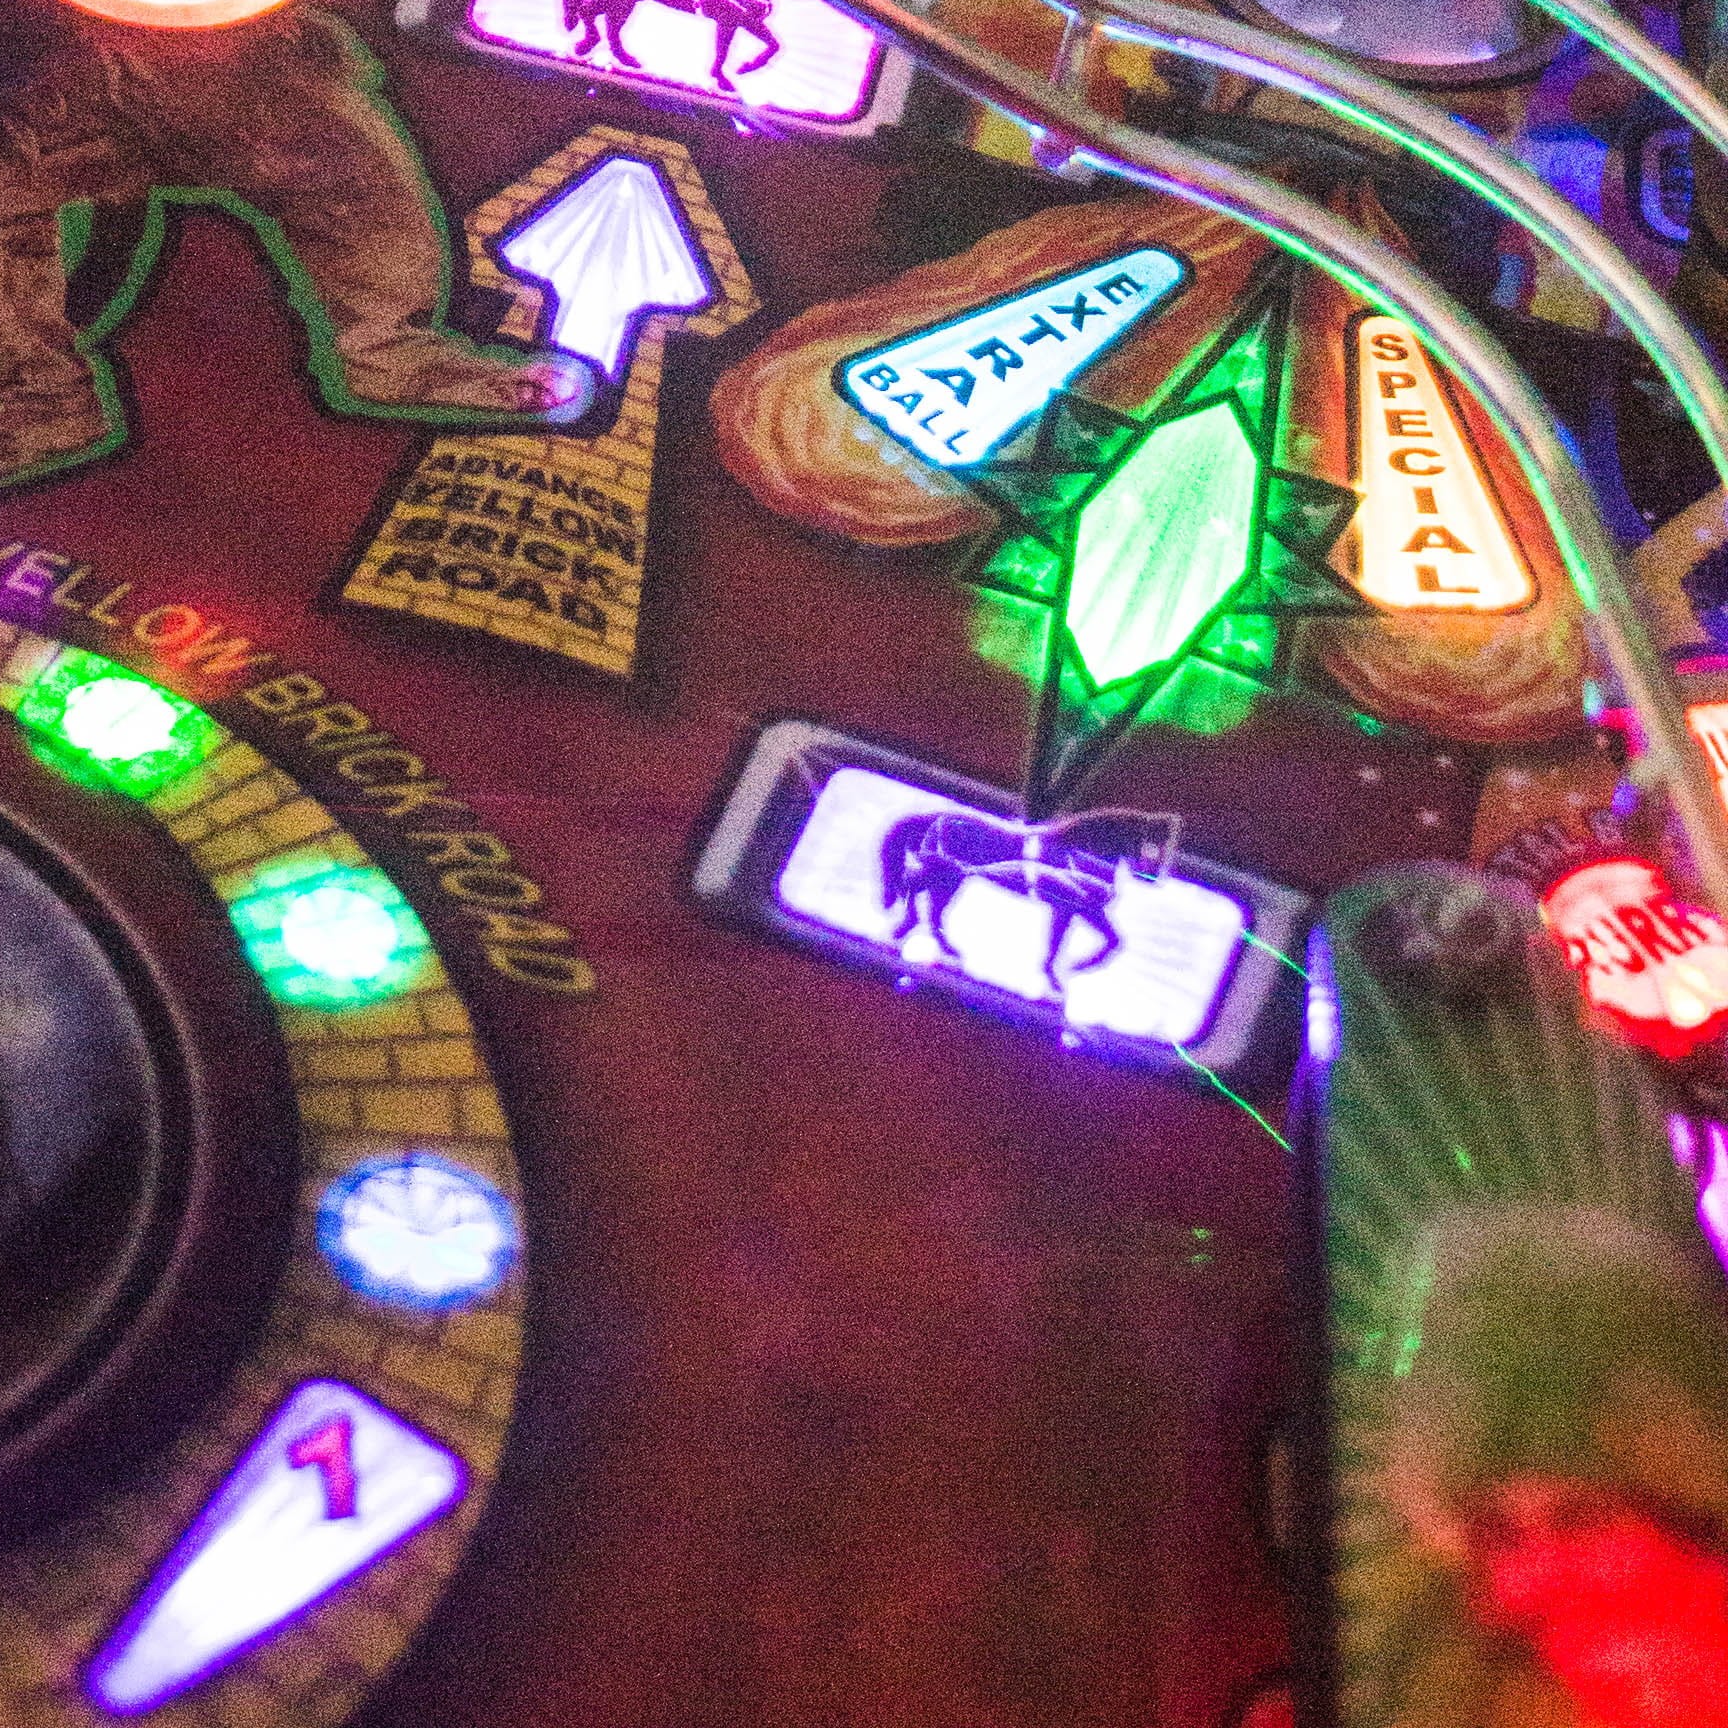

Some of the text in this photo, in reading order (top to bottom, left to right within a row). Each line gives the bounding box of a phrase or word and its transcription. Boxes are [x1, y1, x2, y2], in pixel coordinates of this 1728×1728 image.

[917, 271, 1148, 408] EXTRA
[858, 362, 970, 456] BALL
[426, 454, 635, 528] ADVANCE
[1371, 333, 1481, 594] SPECIAL
[396, 516, 620, 596] BRICK
[402, 479, 636, 564] YELLOW
[377, 552, 609, 633] ROAD
[245, 672, 474, 817] BRICK
[408, 829, 597, 994] ROAD
[286, 1413, 357, 1522] 1
